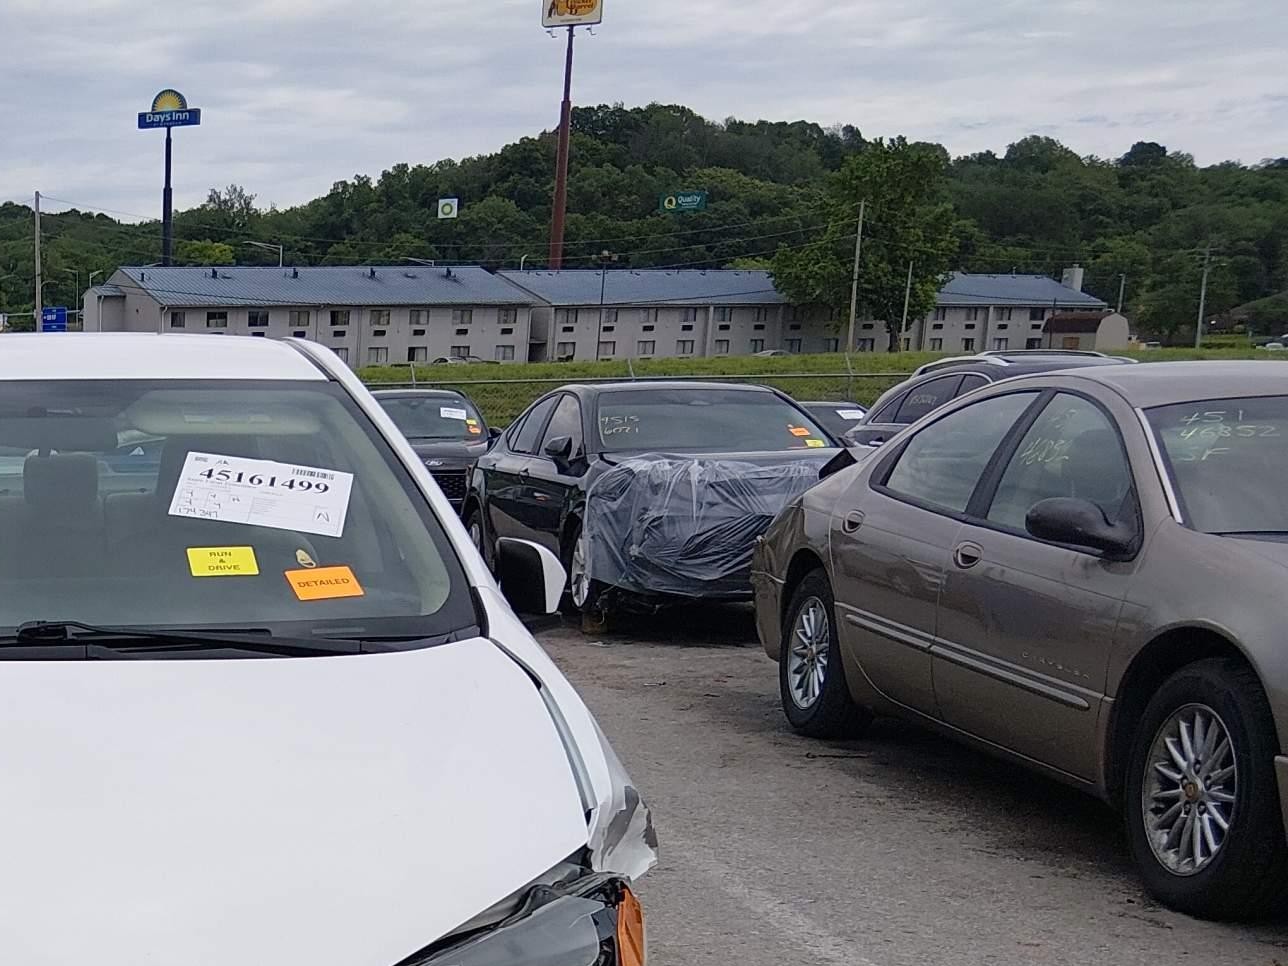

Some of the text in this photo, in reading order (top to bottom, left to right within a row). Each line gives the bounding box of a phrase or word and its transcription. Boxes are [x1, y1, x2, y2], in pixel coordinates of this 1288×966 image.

[145, 111, 190, 123] Days Inn
[199, 467, 329, 494] 45161499
[297, 577, 350, 589] DETAILED
